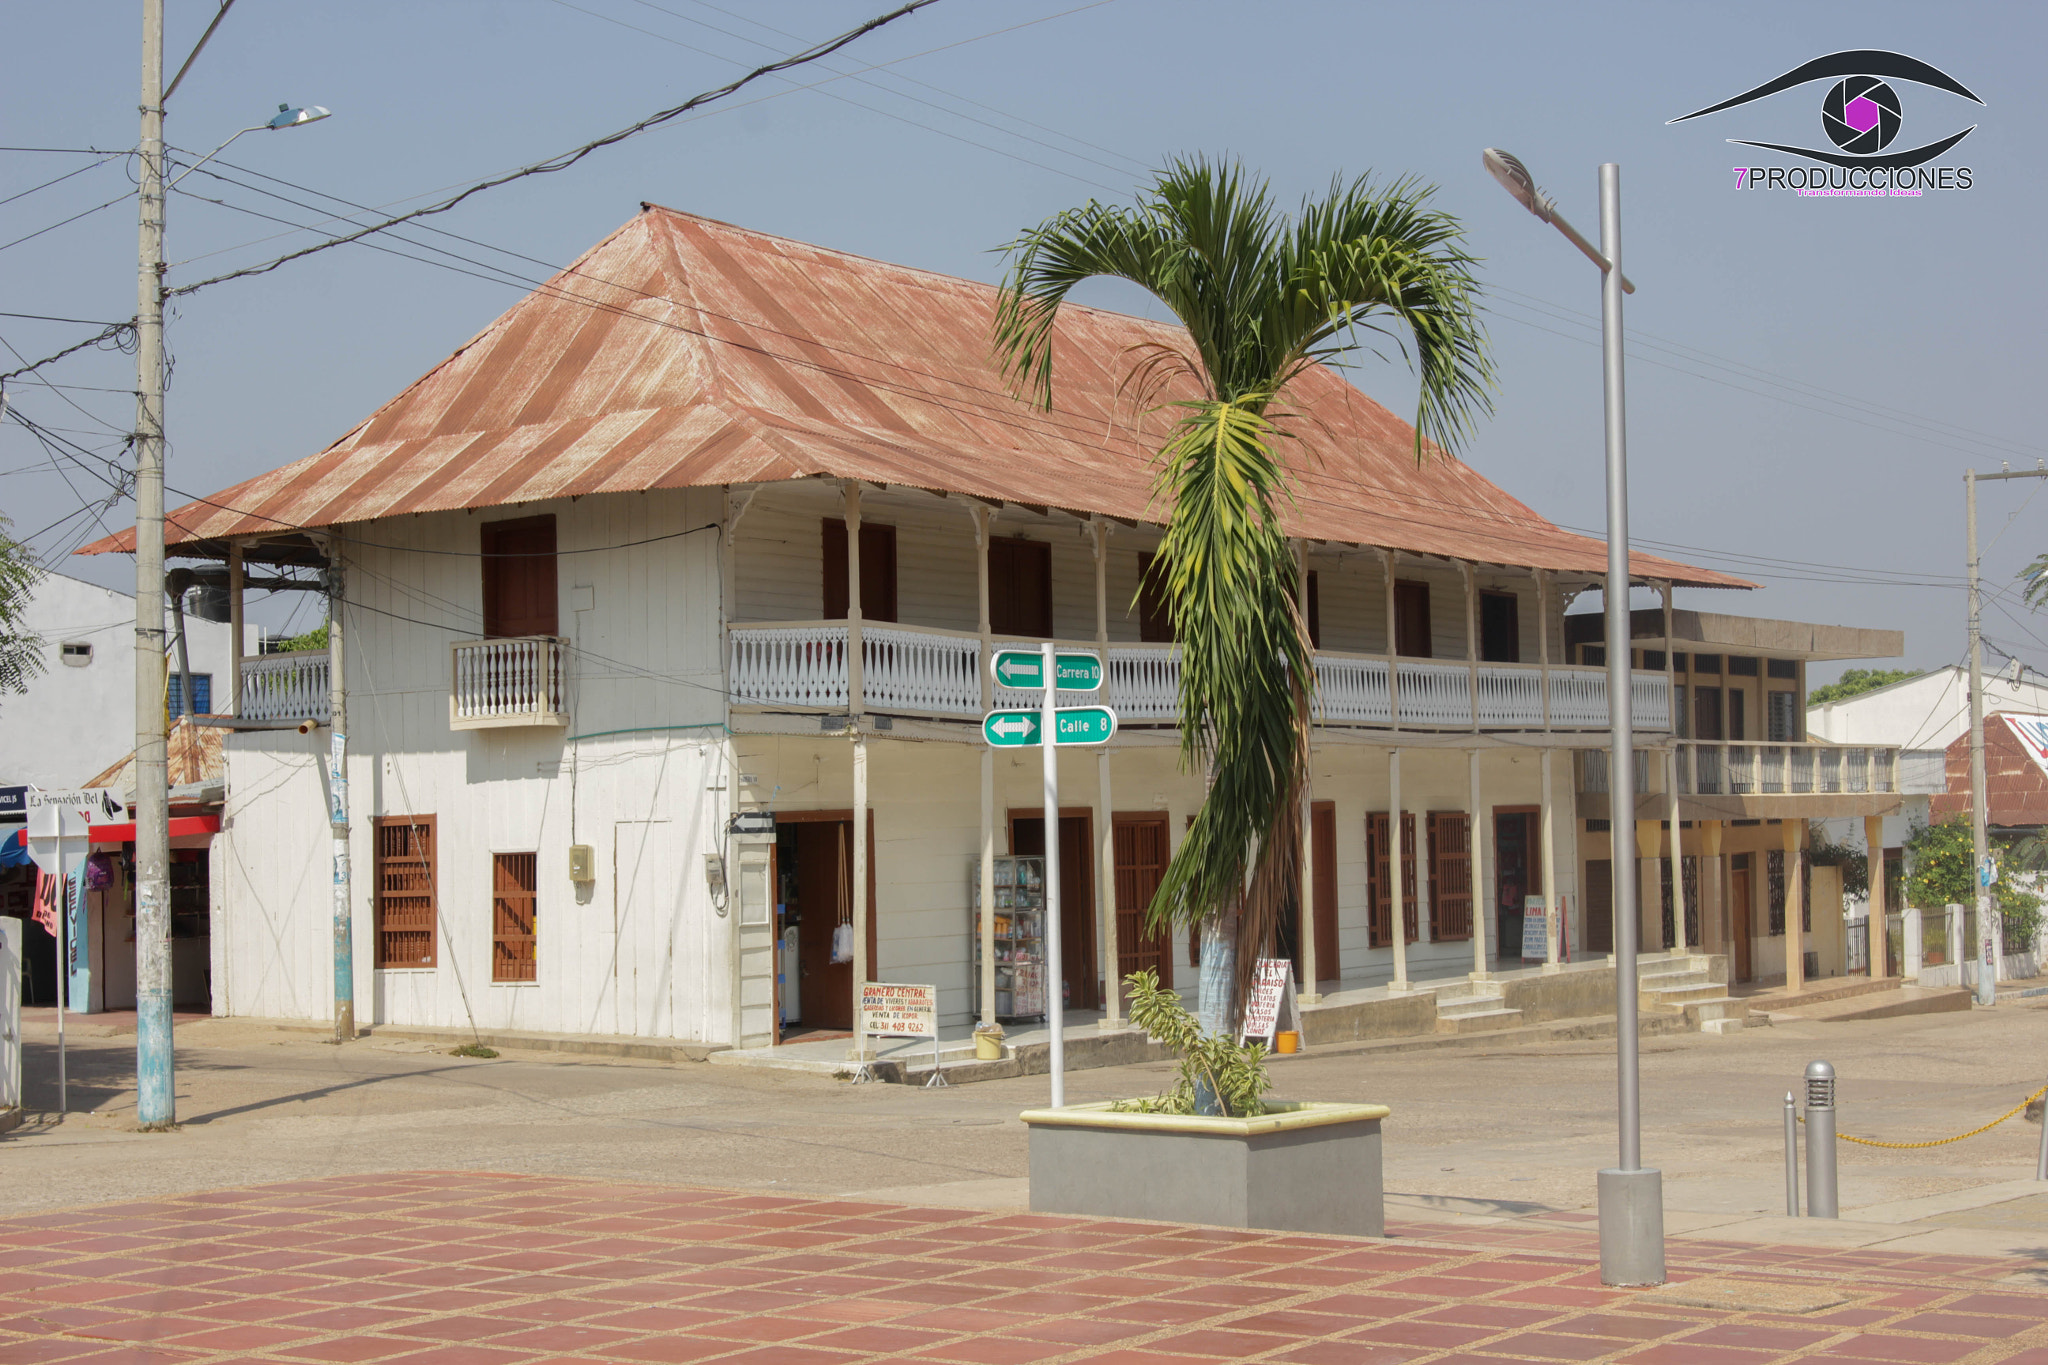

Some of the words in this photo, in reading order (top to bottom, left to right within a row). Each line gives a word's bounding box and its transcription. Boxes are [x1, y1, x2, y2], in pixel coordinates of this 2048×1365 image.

[1056, 664, 1089, 679] Carrera
[1091, 665, 1099, 679] 10
[1060, 718, 1090, 733] Calle
[1100, 717, 1108, 731] 8
[864, 987, 895, 997] GRANERO
[897, 987, 926, 999] CENTRAL
[881, 1021, 890, 1031] 311
[892, 1022, 906, 1032] 403
